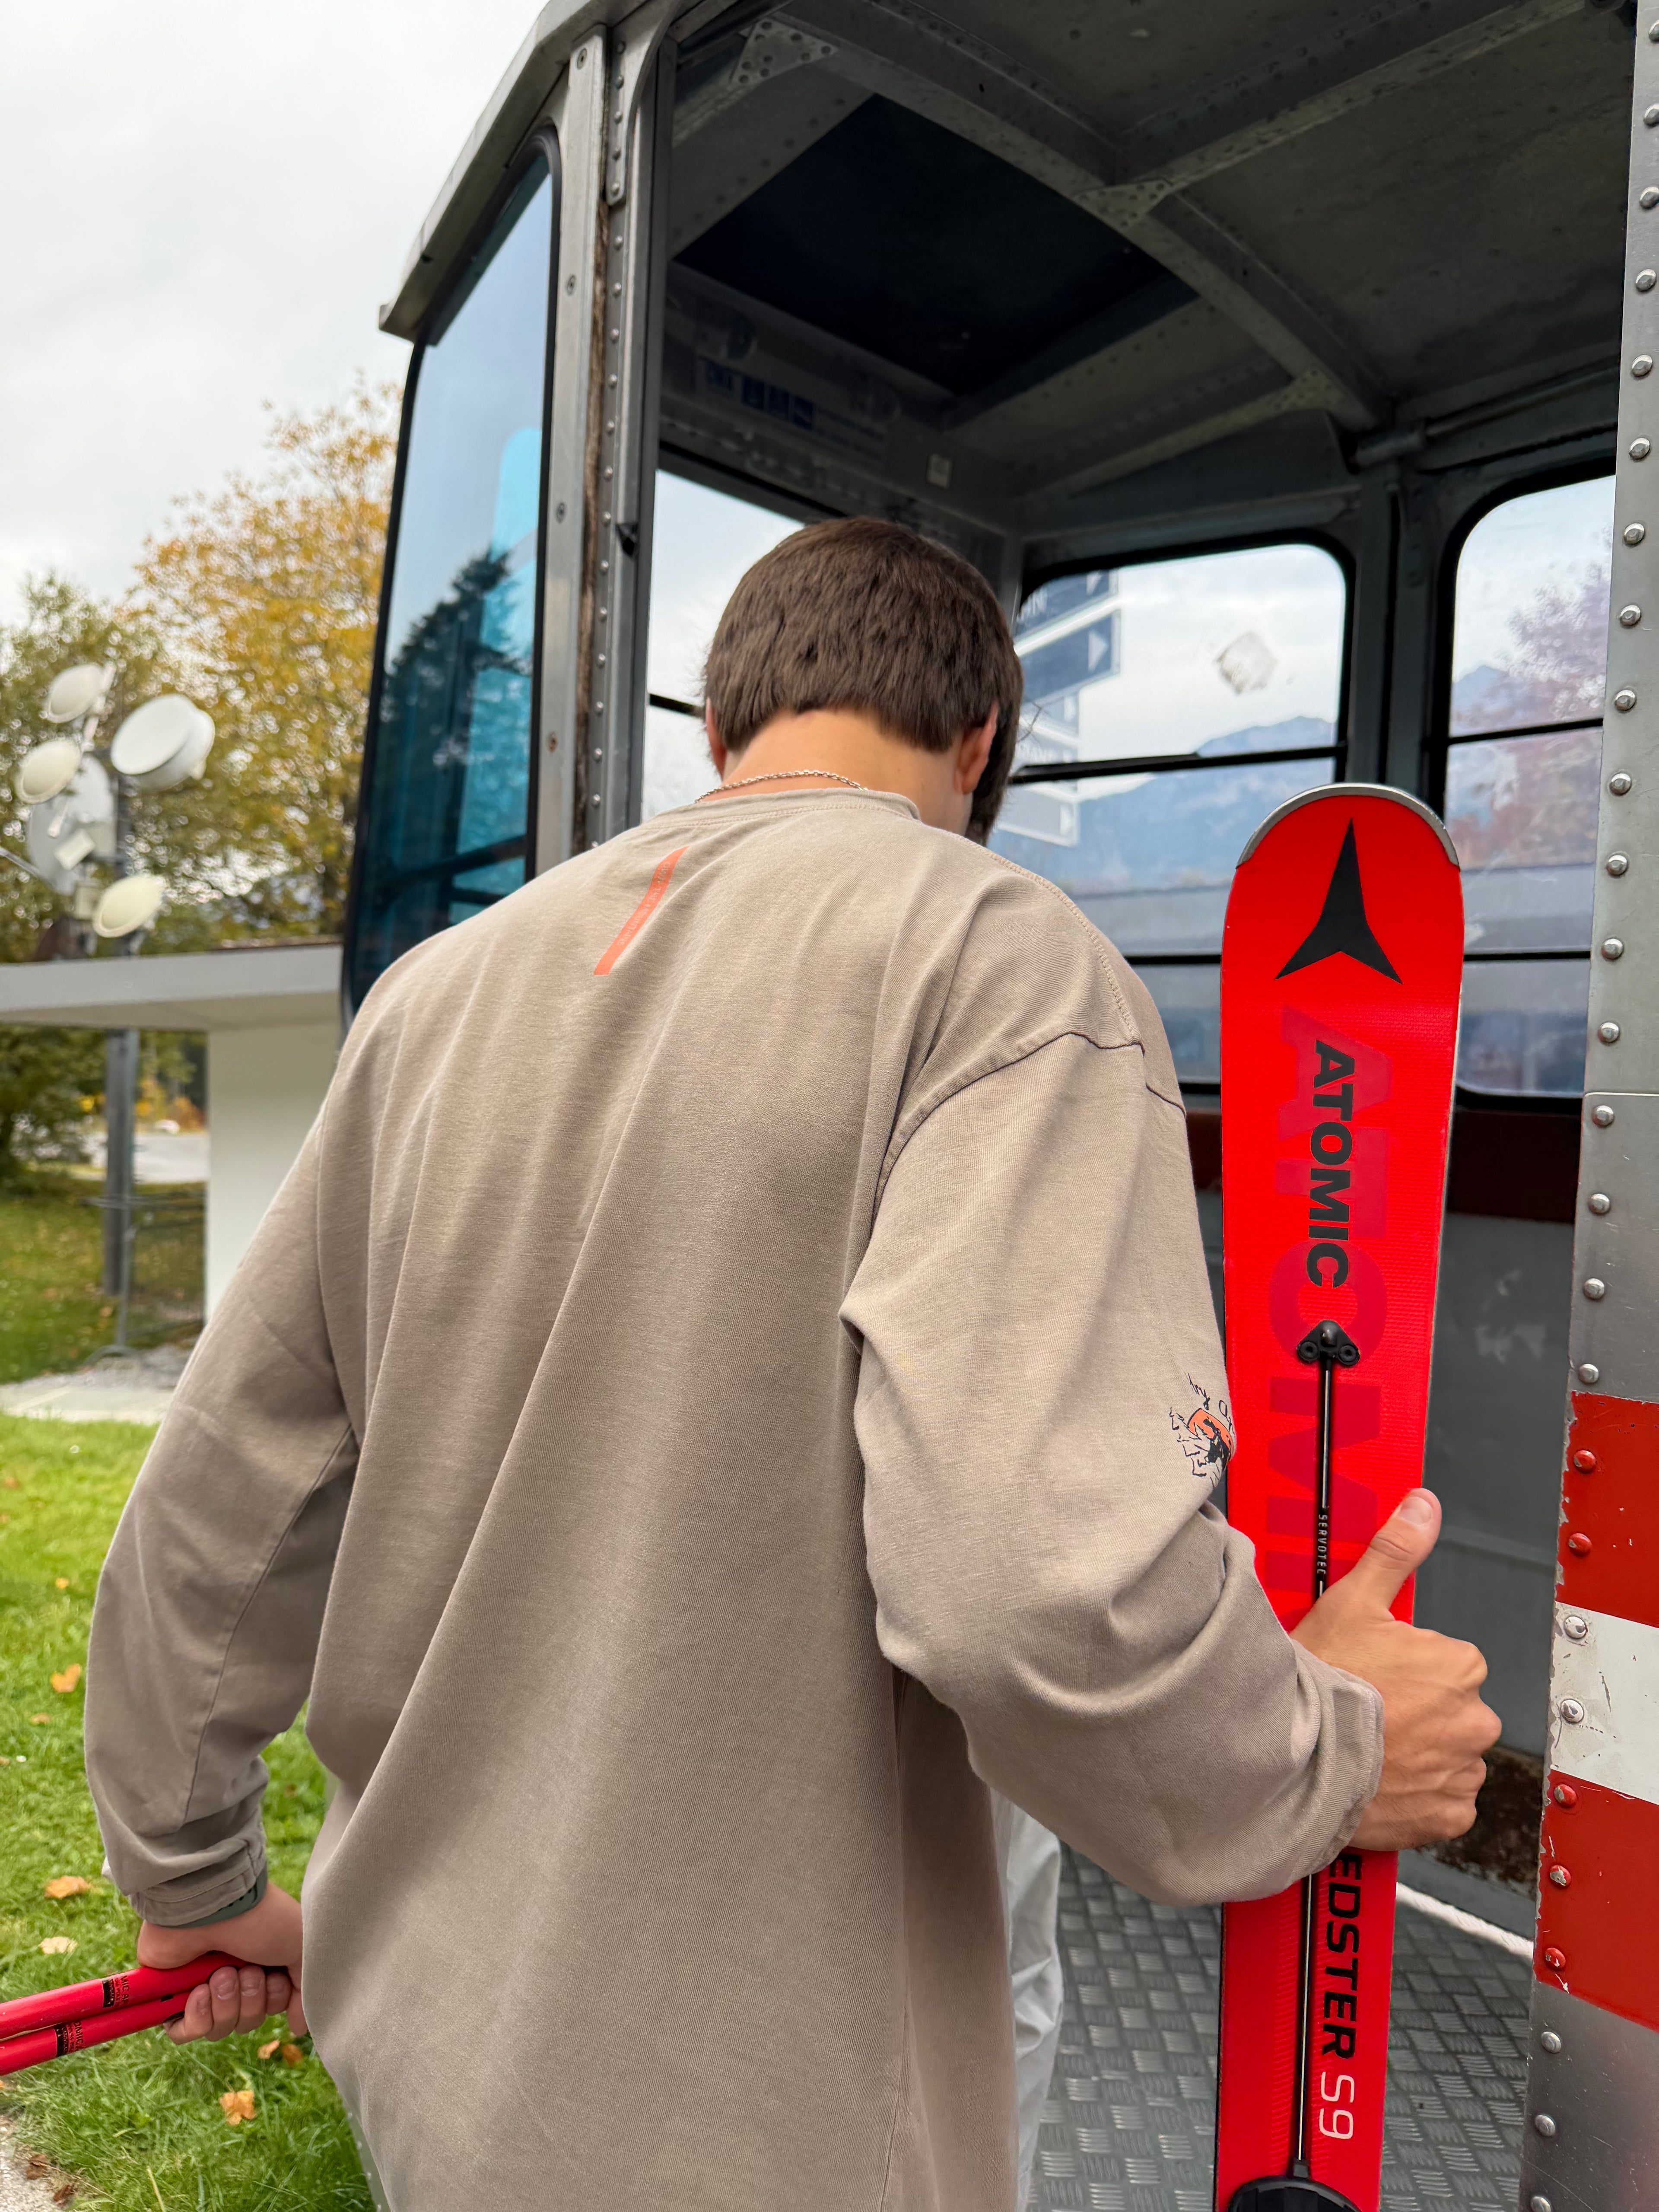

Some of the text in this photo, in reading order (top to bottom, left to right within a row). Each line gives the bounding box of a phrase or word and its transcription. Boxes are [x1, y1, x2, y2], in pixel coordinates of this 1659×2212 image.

[1306, 1040, 1355, 1288] ATOMIC
[1265, 1004, 1392, 1628] ATOMI
[1317, 1514, 1328, 1575] SERVOTEC
[1319, 1853, 1362, 2139] EDSTER S9
